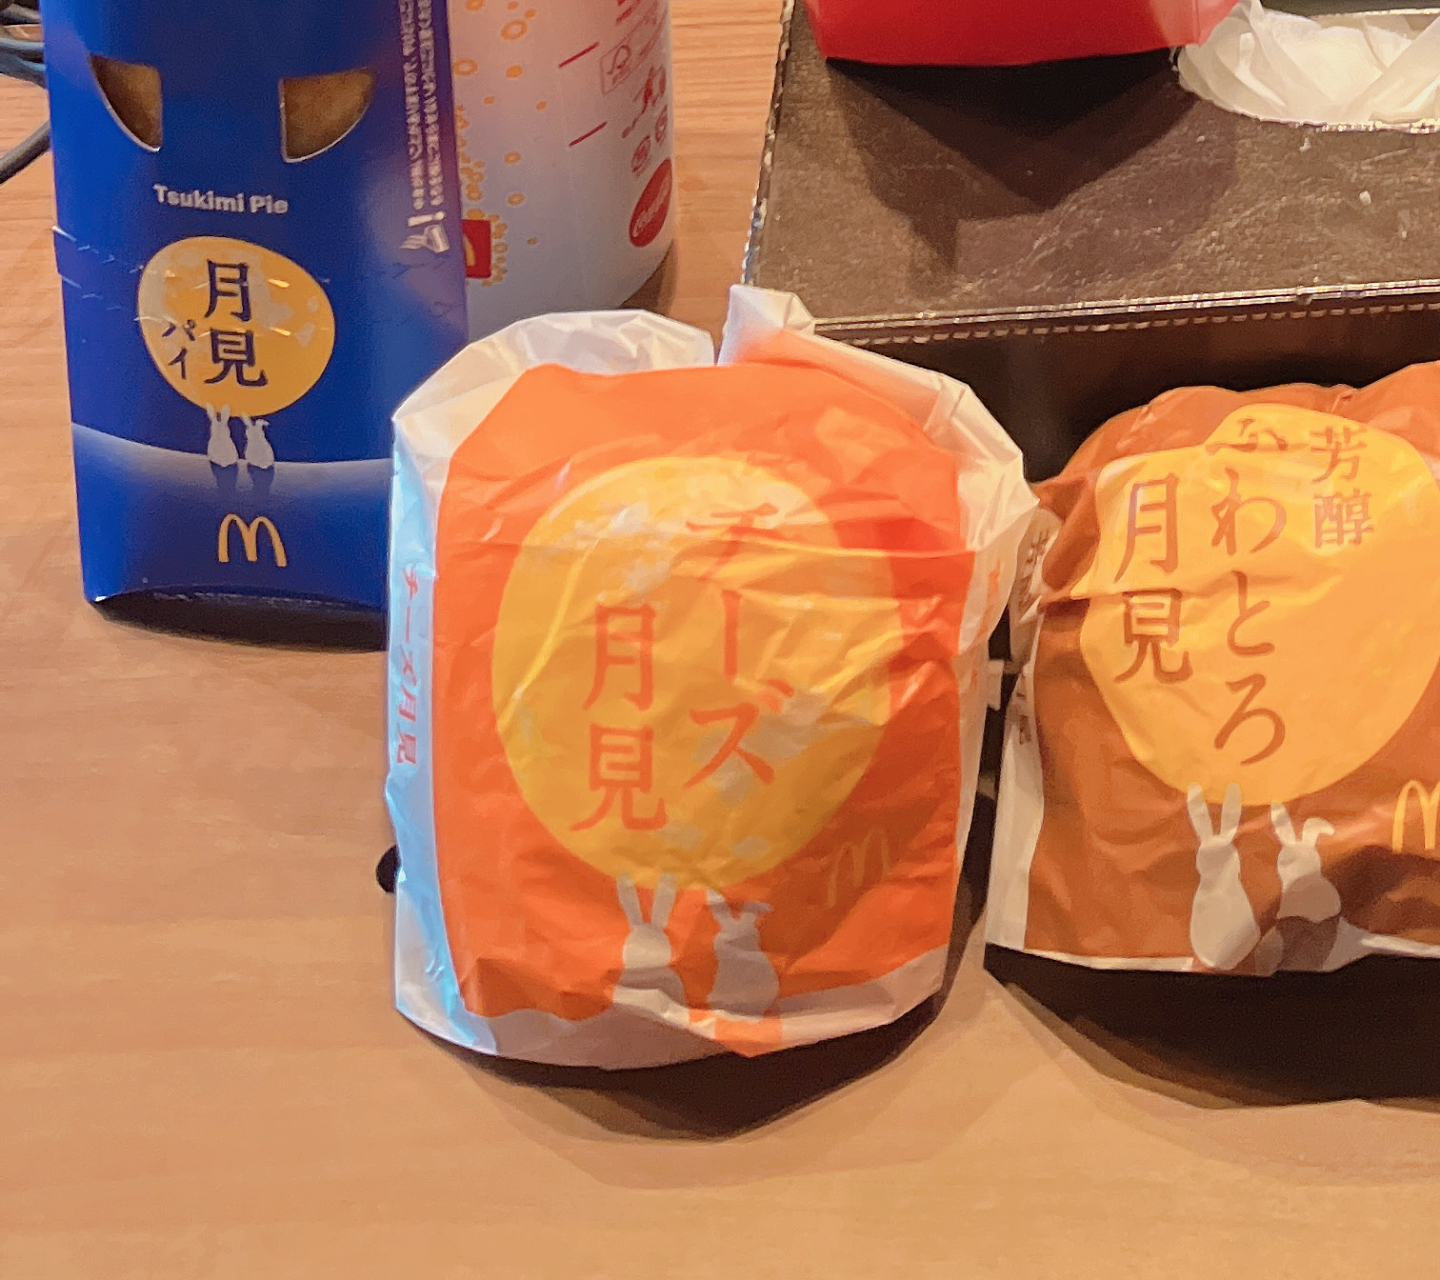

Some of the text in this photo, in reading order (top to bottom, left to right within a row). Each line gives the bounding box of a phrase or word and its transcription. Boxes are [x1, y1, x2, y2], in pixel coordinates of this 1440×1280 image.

[153, 183, 289, 214] Tsukimi Pie
[161, 319, 197, 380] パイ
[204, 258, 268, 387] 月見
[1309, 423, 1375, 549] 芳醇
[683, 502, 795, 790] チーズ
[1113, 470, 1194, 685] 月見
[1204, 418, 1290, 767] ふわとろ
[570, 603, 670, 832] 月見
